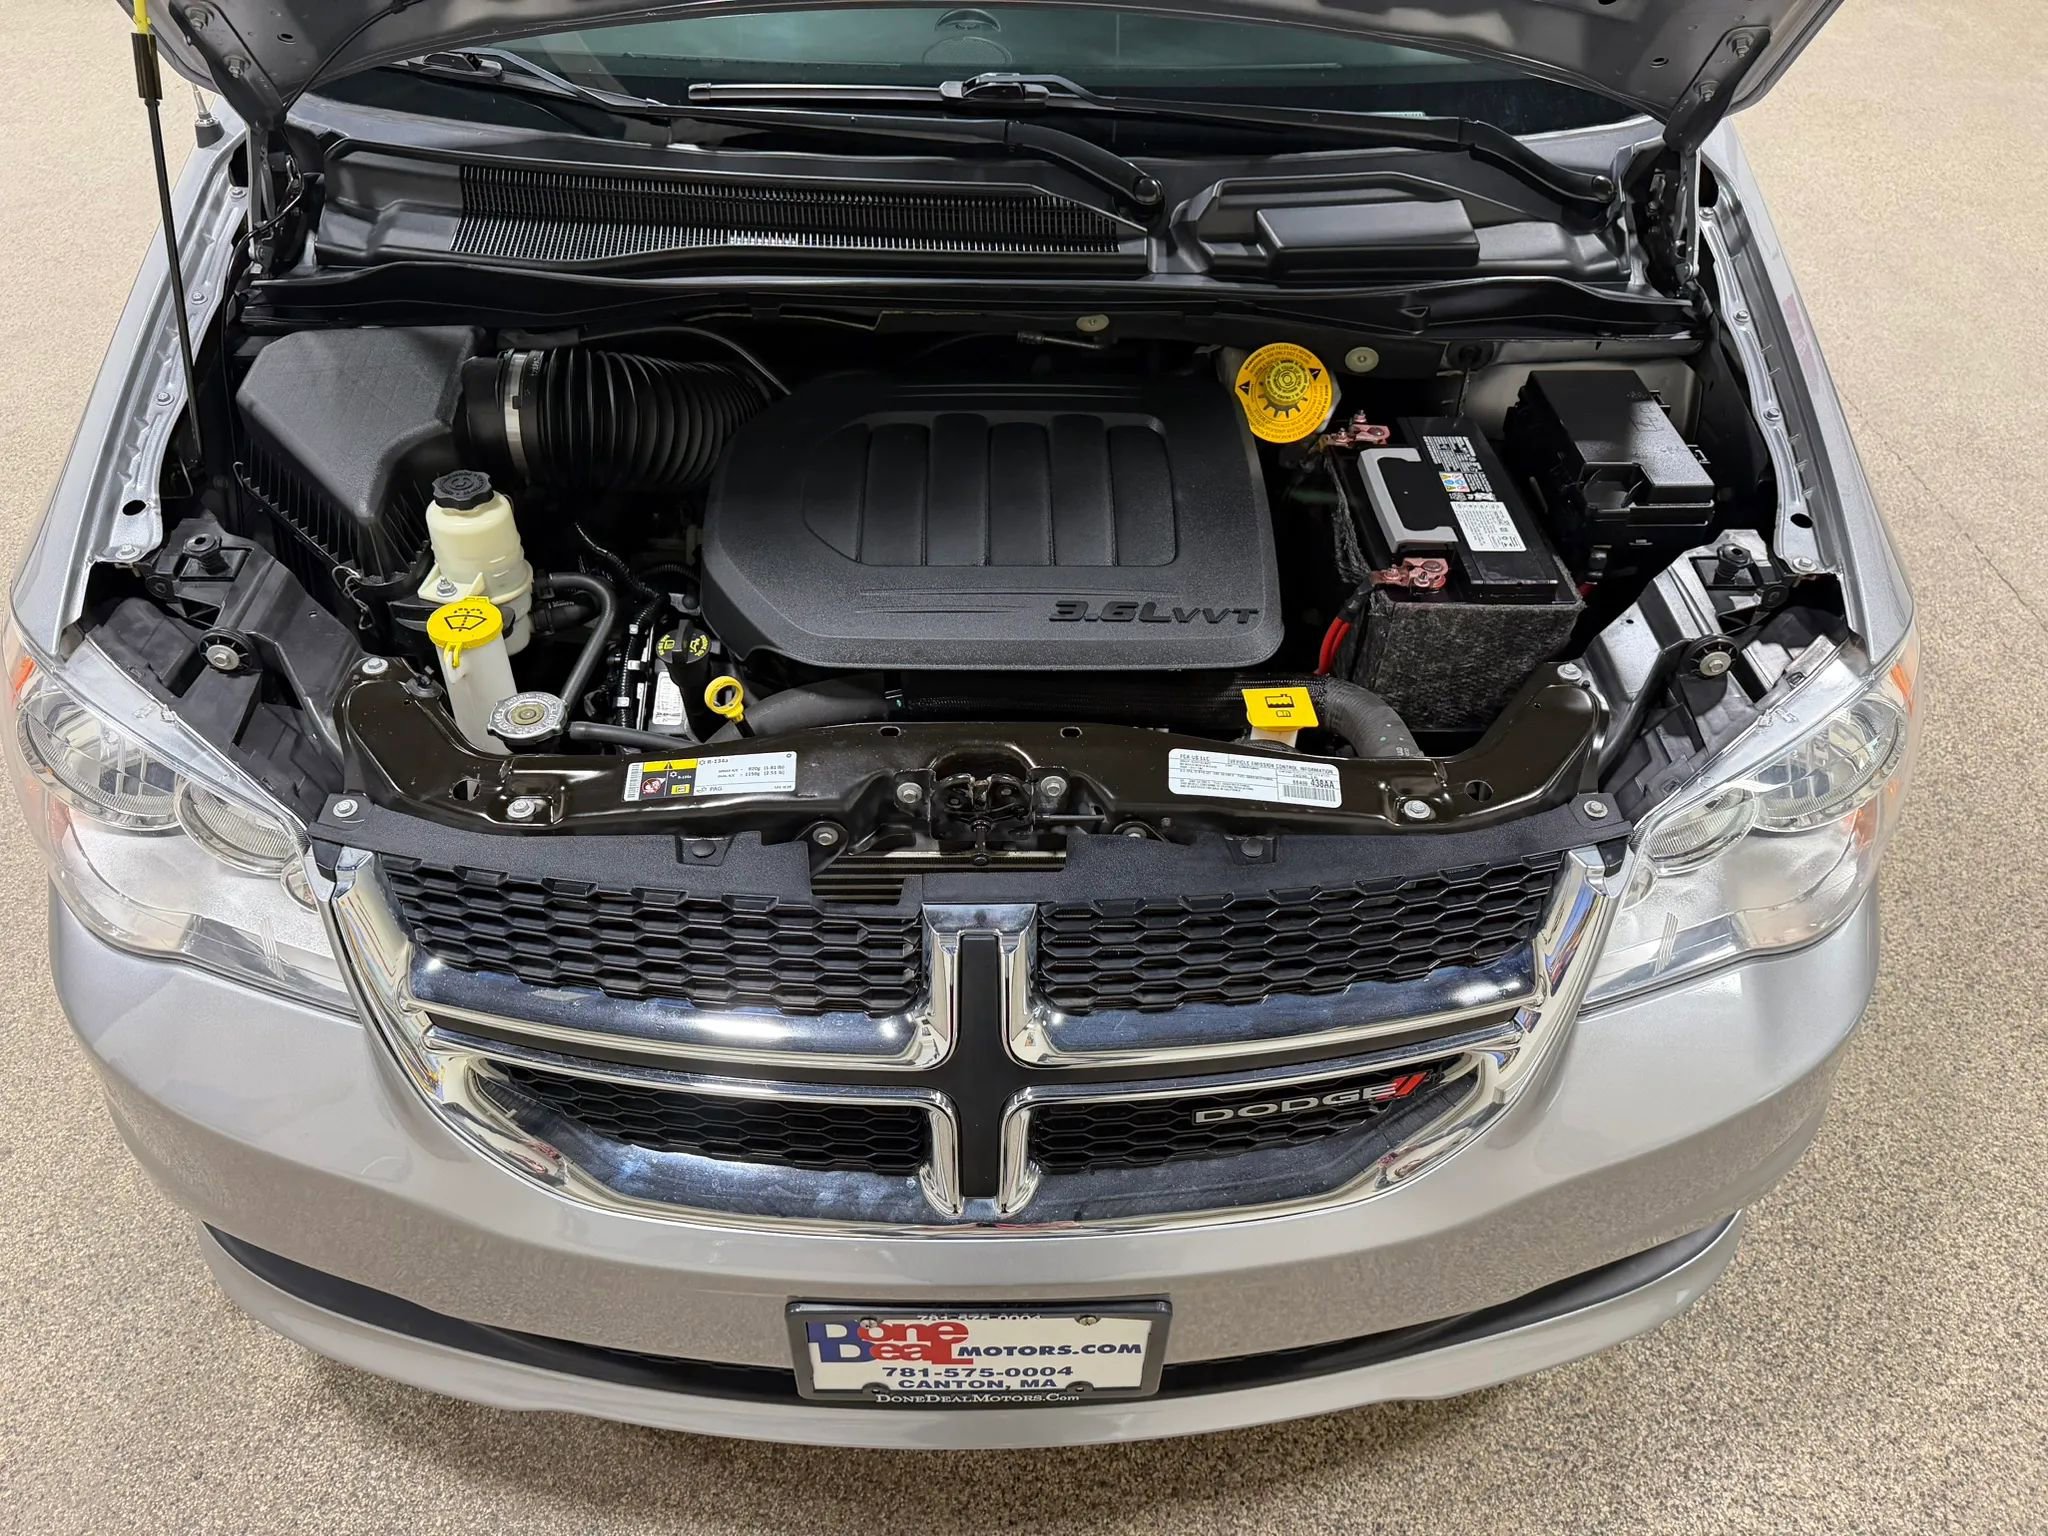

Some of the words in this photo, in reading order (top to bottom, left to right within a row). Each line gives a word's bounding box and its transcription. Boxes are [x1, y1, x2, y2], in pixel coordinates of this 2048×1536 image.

[1195, 1083, 1397, 1123] DODGE
[957, 1343, 1142, 1357] MOTORS.COM
[882, 1366, 1074, 1378] 781-575-0004
[898, 1379, 1011, 1391] CANTON,
[1020, 1379, 1057, 1388] MA
